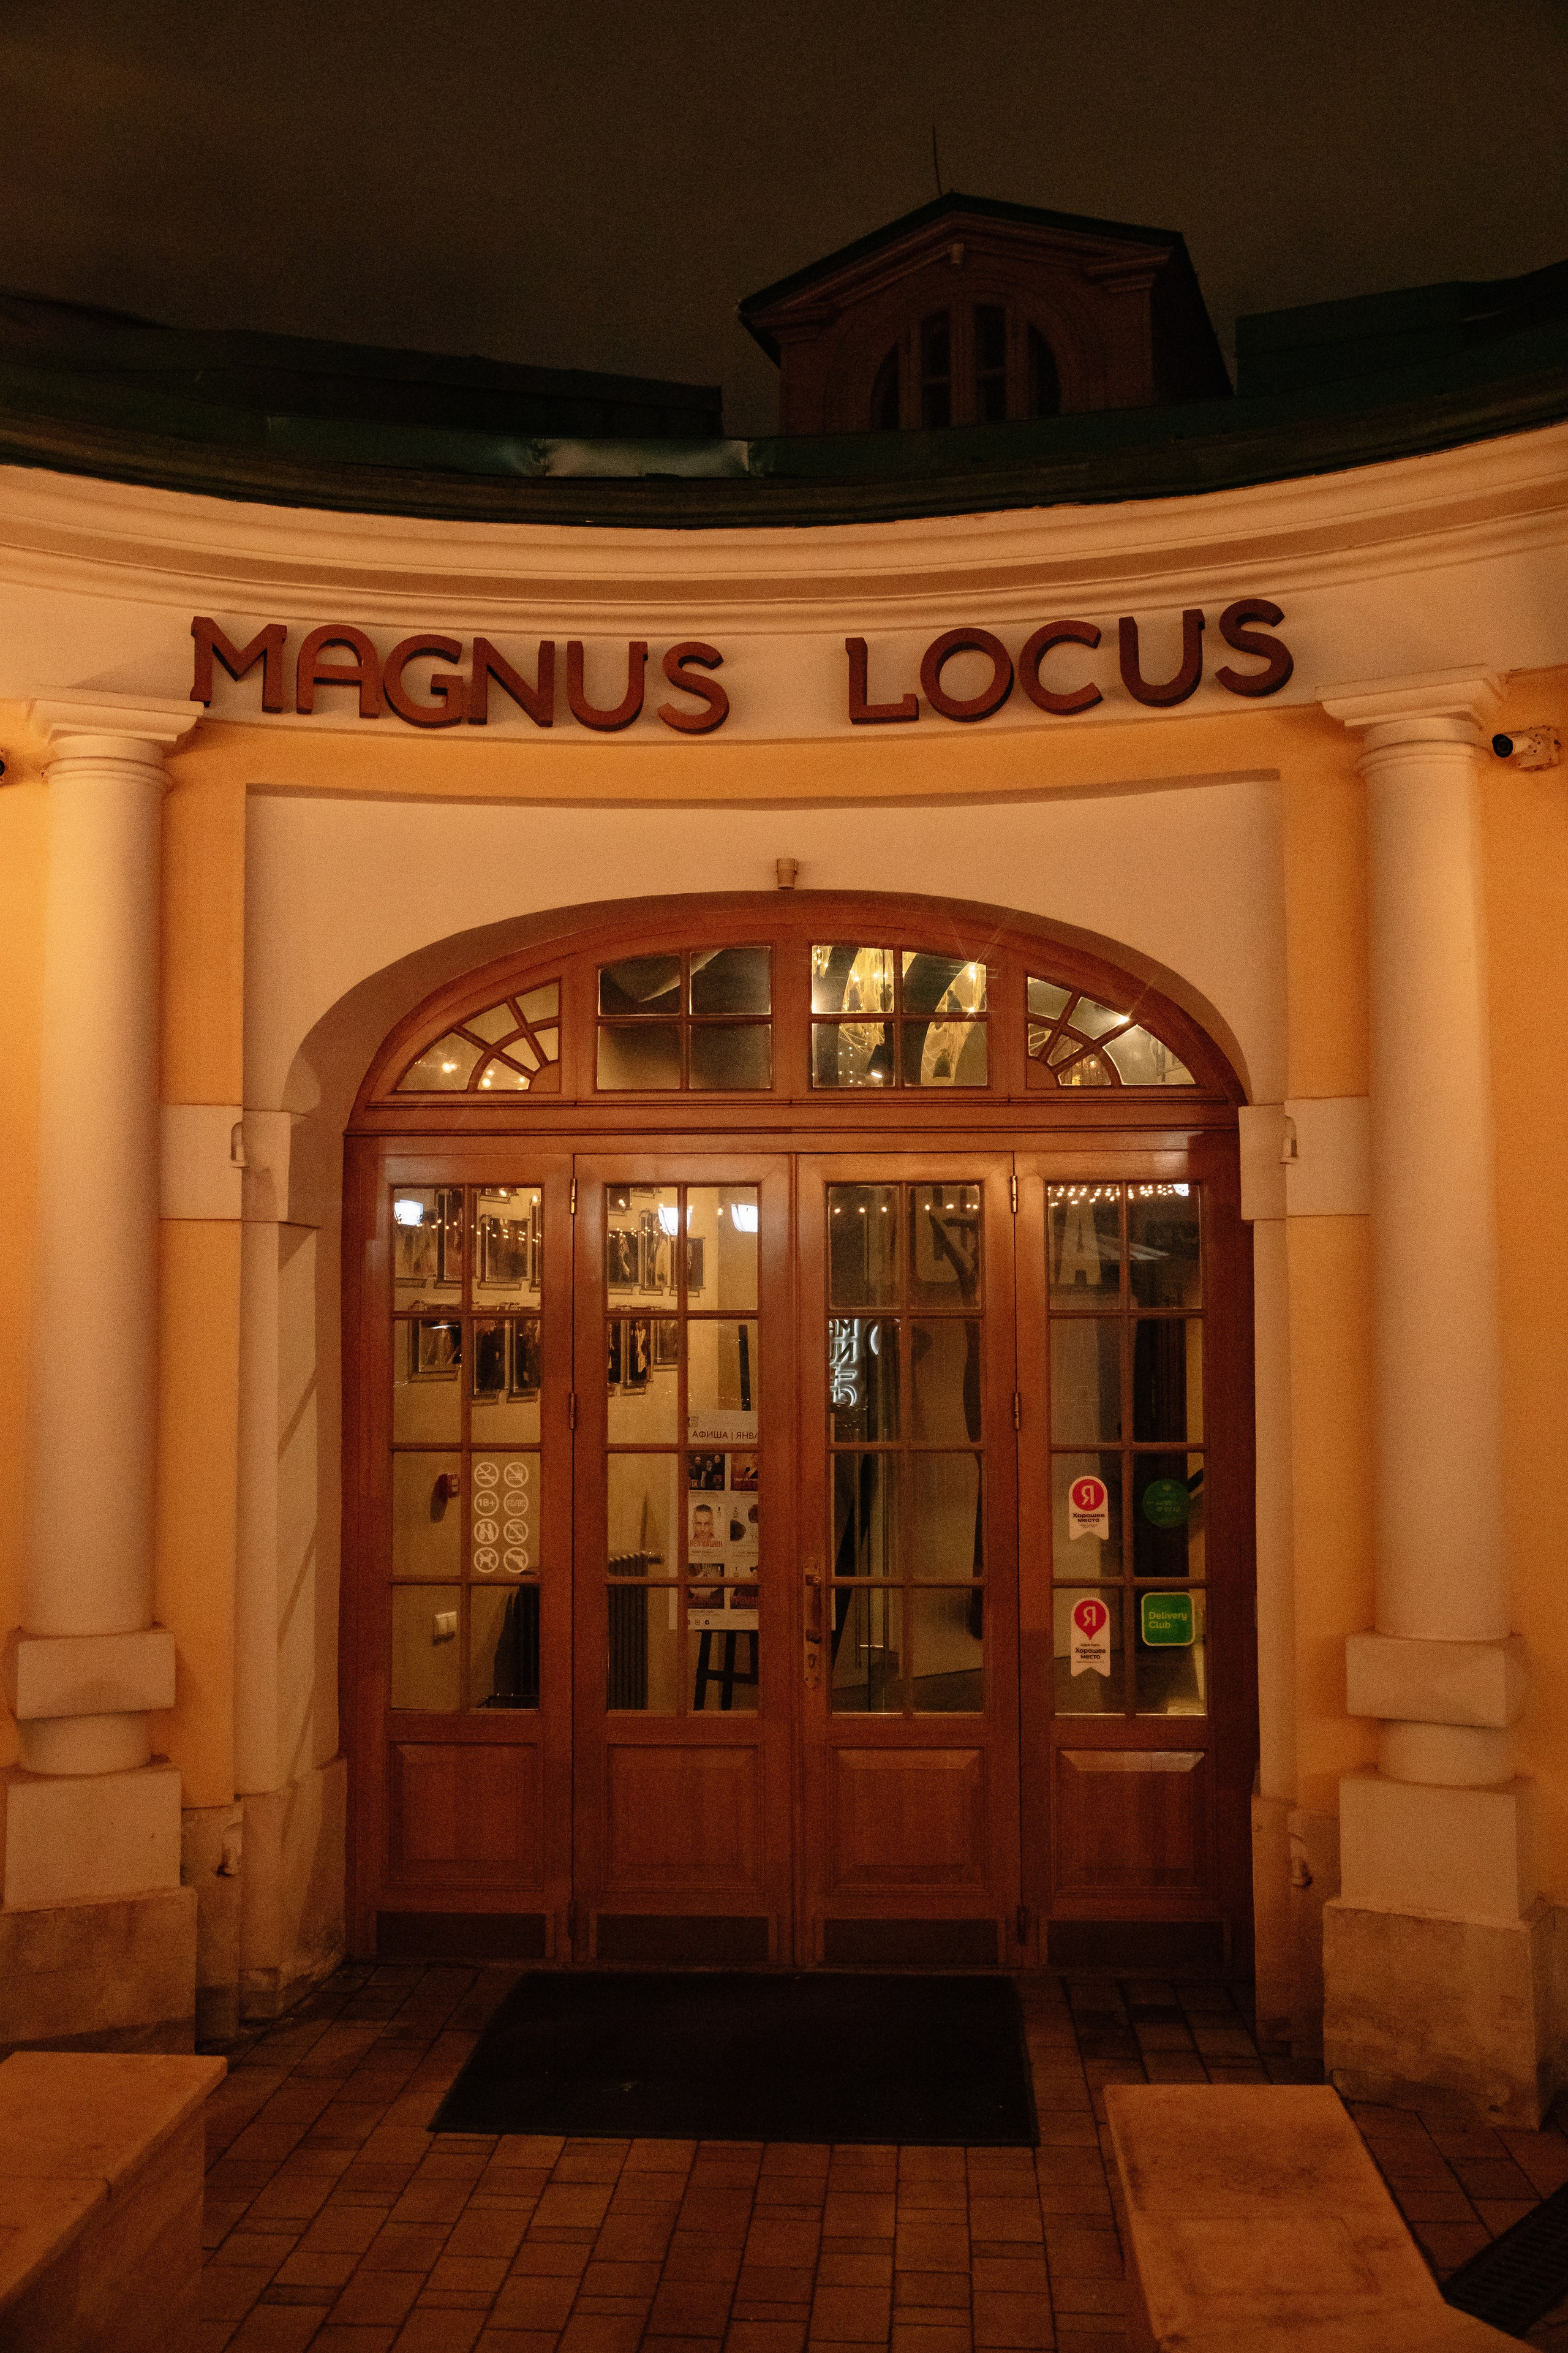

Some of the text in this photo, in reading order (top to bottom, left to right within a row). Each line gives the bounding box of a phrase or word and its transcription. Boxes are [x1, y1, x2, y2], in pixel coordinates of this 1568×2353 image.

[190, 599, 1294, 734] MAGNUS LOCUS
[692, 1430, 728, 1439] АФИША
[1081, 1485, 1095, 1505] Я
[1084, 1606, 1096, 1626] Я
[1148, 1611, 1187, 1621] Delivery
[1148, 1620, 1171, 1629] Club
